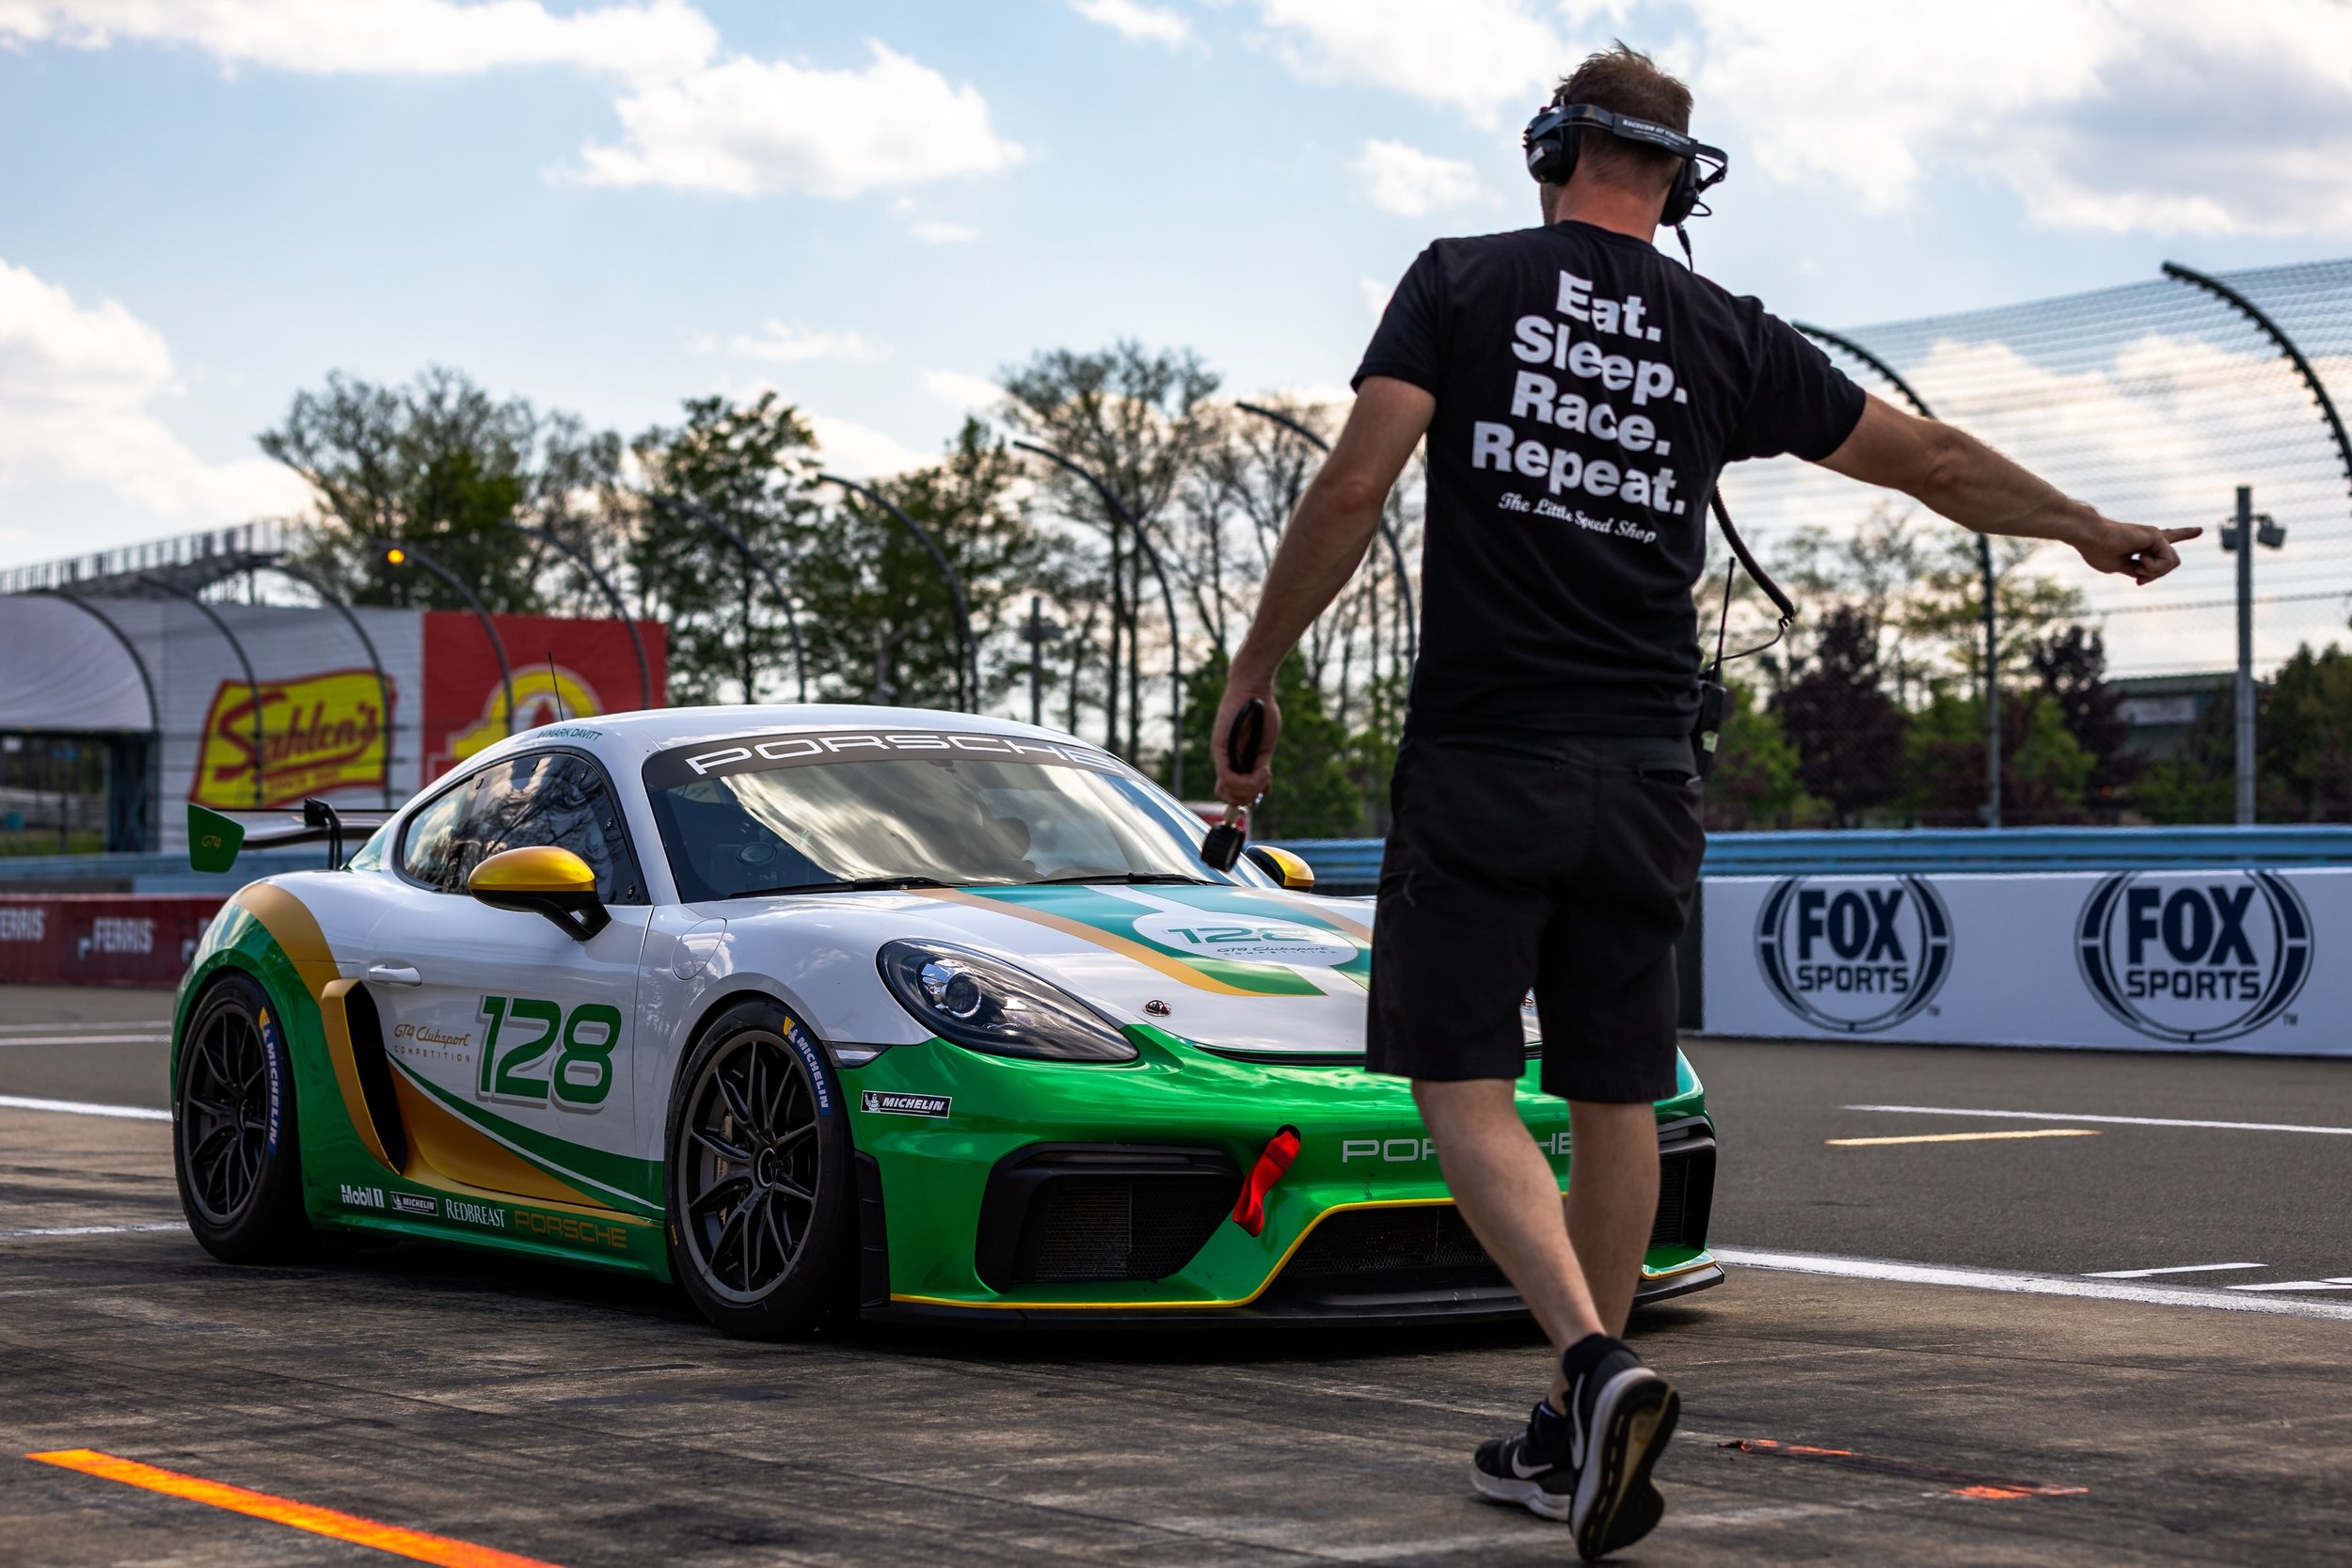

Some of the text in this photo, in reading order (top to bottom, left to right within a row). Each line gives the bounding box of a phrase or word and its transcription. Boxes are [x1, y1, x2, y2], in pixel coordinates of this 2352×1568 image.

[1556, 269, 1662, 342] Eat.
[1511, 314, 1689, 406] Sleep.
[1510, 370, 1672, 456] Race.
[1471, 420, 1686, 515] Repeat.
[1498, 492, 1657, 544] The Little Speed Shop
[548, 728, 603, 741] MARK DAVITT
[684, 735, 1126, 776] PORSCHE
[0, 908, 44, 939] ERRIS
[93, 917, 153, 952] FERRIS
[1167, 927, 1313, 944] 128
[1798, 889, 1907, 963] FOX
[2127, 885, 2258, 967] FOX
[1798, 964, 1910, 993] SPORTS
[2126, 970, 2262, 1001] SPORTS
[393, 1023, 471, 1049] GT4 Clubsport
[394, 1045, 470, 1063] COMPETITION
[476, 994, 623, 1114] 128
[796, 1037, 829, 1108] MICHELIN
[266, 1042, 279, 1145] MICHELIN
[882, 1097, 946, 1111] MICHELIN
[341, 1184, 373, 1207] Mobil
[403, 1197, 435, 1211] MICHELIN
[445, 1198, 505, 1227] REDBREAST
[515, 1210, 628, 1249] PORSCHE
